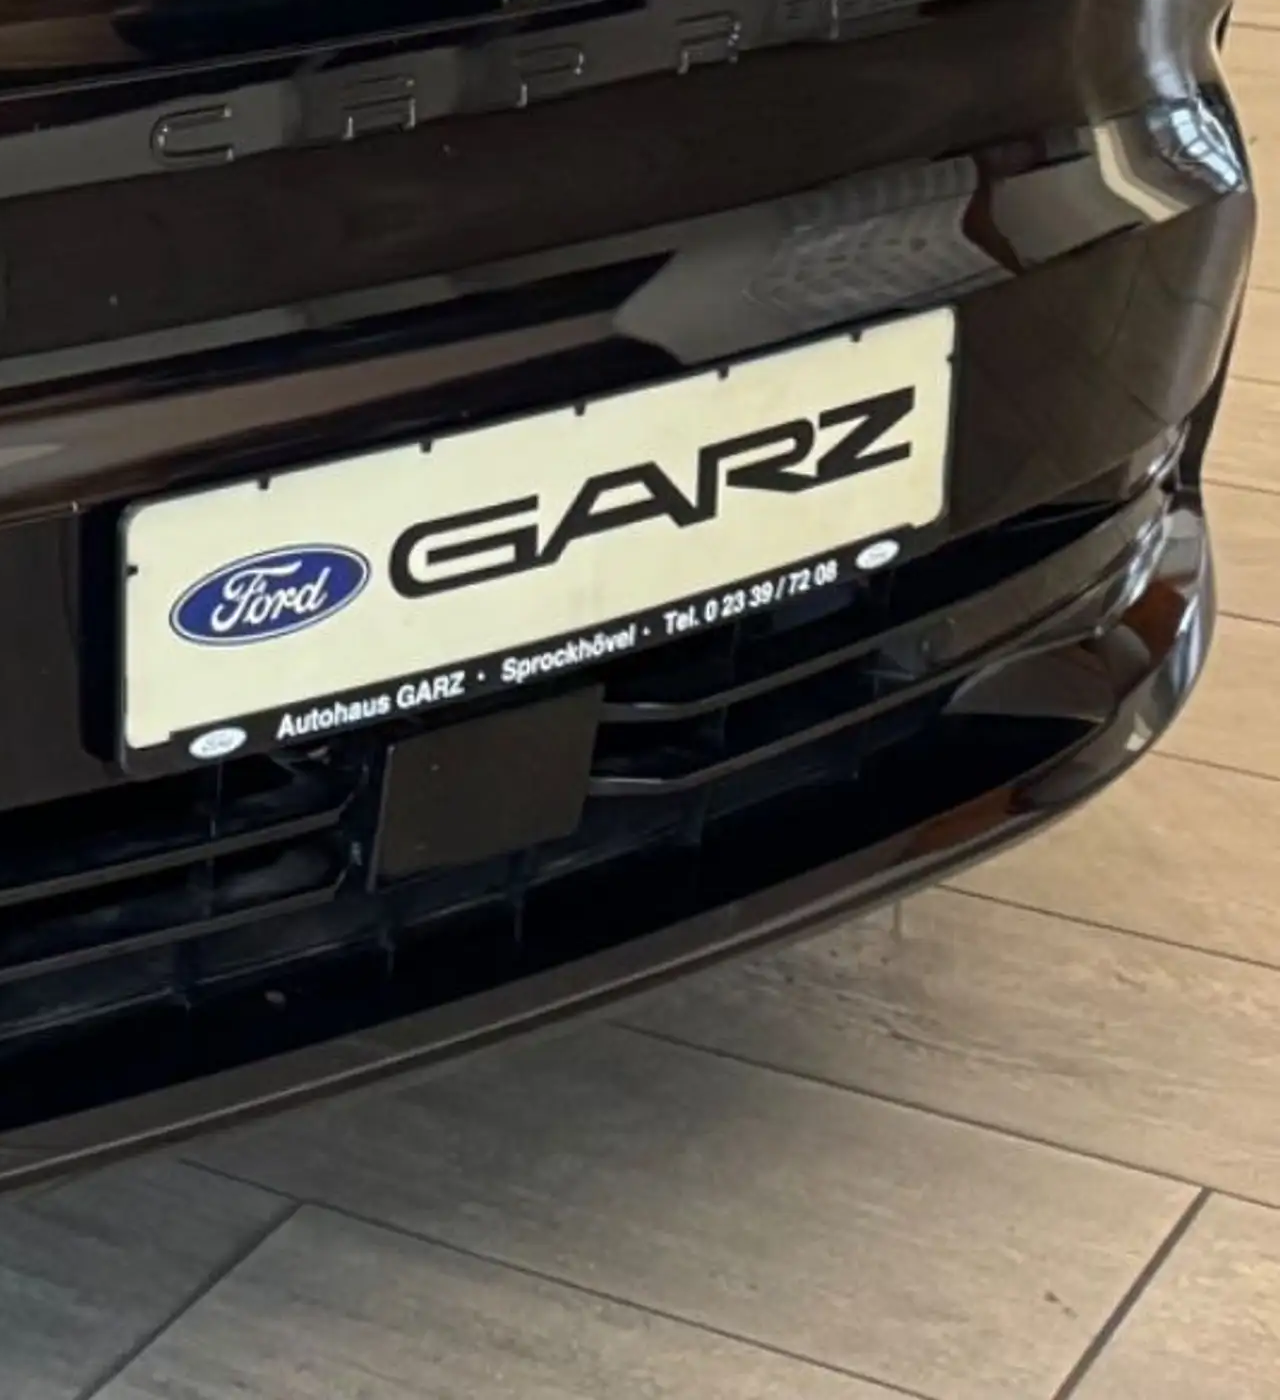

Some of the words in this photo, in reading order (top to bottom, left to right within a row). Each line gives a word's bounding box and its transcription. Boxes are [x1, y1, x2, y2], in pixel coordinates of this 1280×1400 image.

[388, 386, 915, 599] GARZ
[211, 560, 331, 632] Ford
[276, 695, 391, 740] Autohaus
[396, 670, 466, 709] GARZ
[501, 623, 636, 682] Sprockhövel
[663, 607, 698, 635] Tel.
